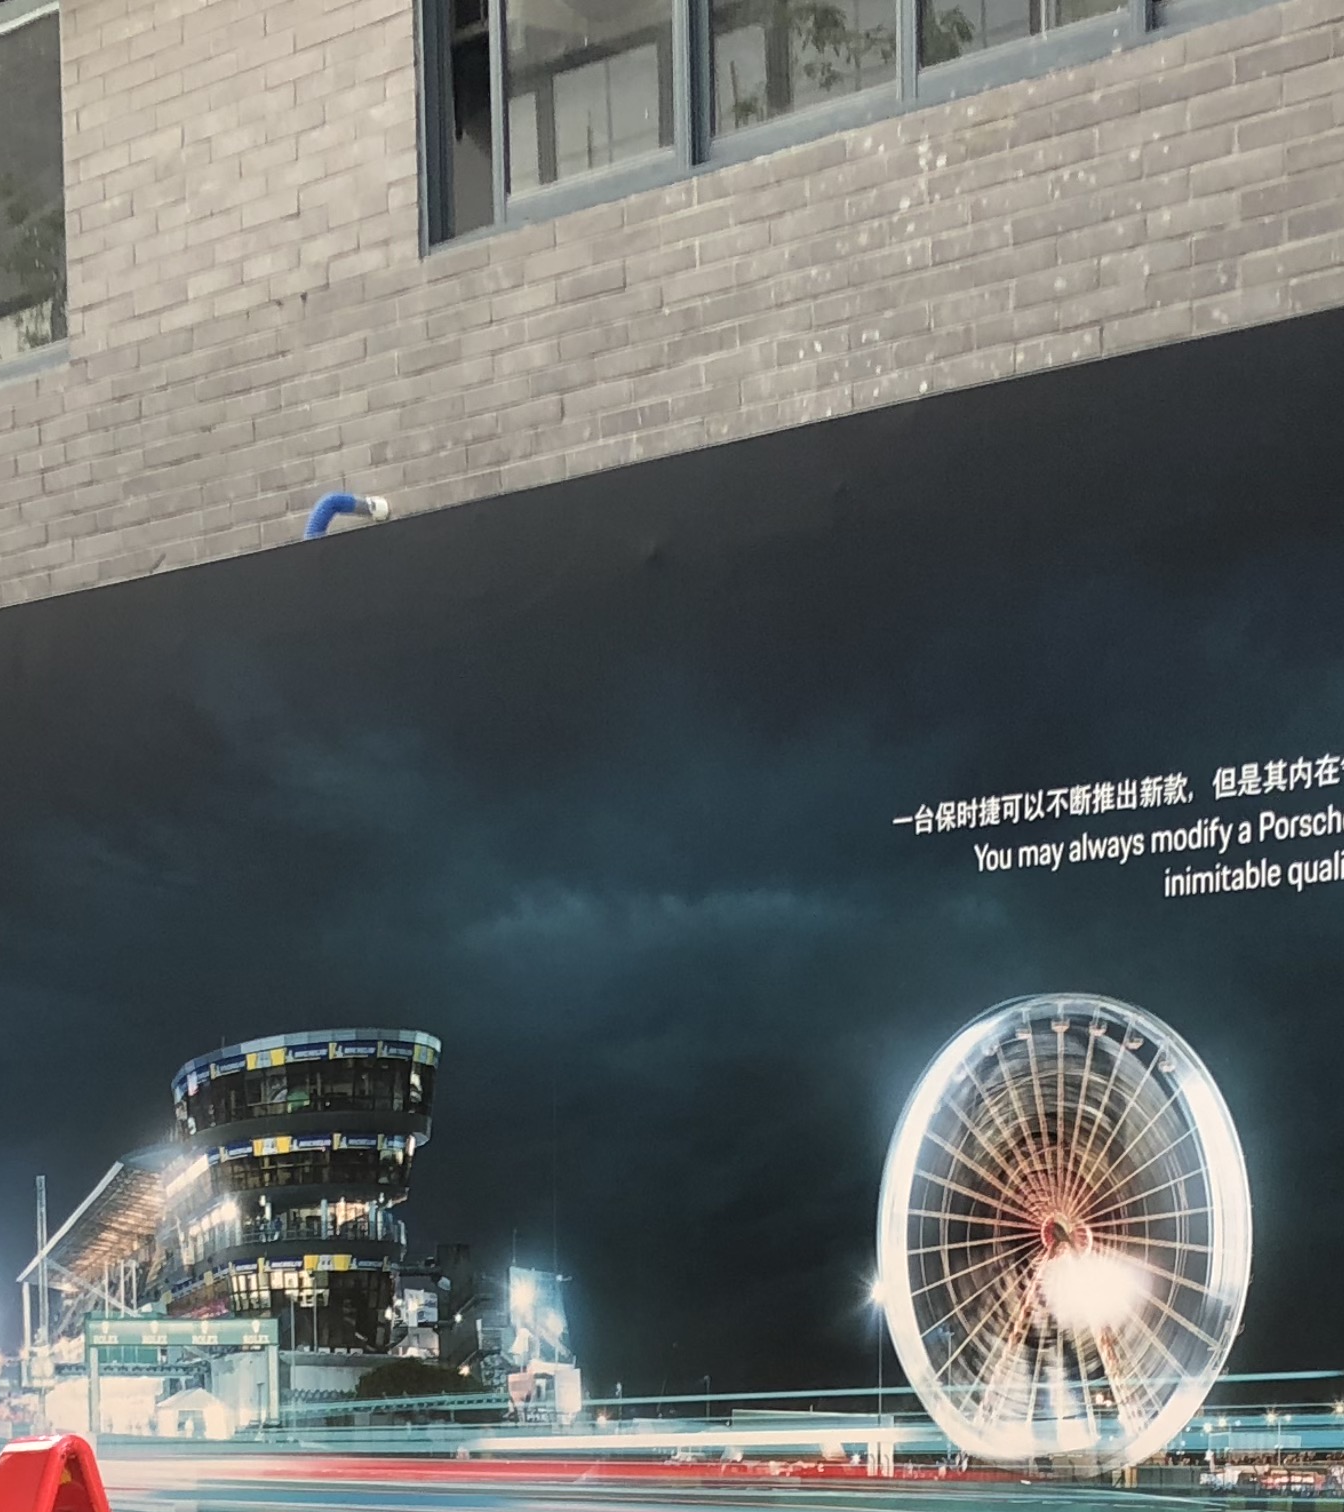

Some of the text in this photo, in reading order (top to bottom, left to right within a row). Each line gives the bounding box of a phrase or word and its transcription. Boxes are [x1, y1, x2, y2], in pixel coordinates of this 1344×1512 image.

[974, 843, 1012, 872] You
[1018, 841, 1064, 872] may
[1069, 832, 1144, 865] always
[1151, 817, 1233, 854] modify
[1238, 820, 1252, 843] a
[1164, 857, 1282, 897] inimitable
